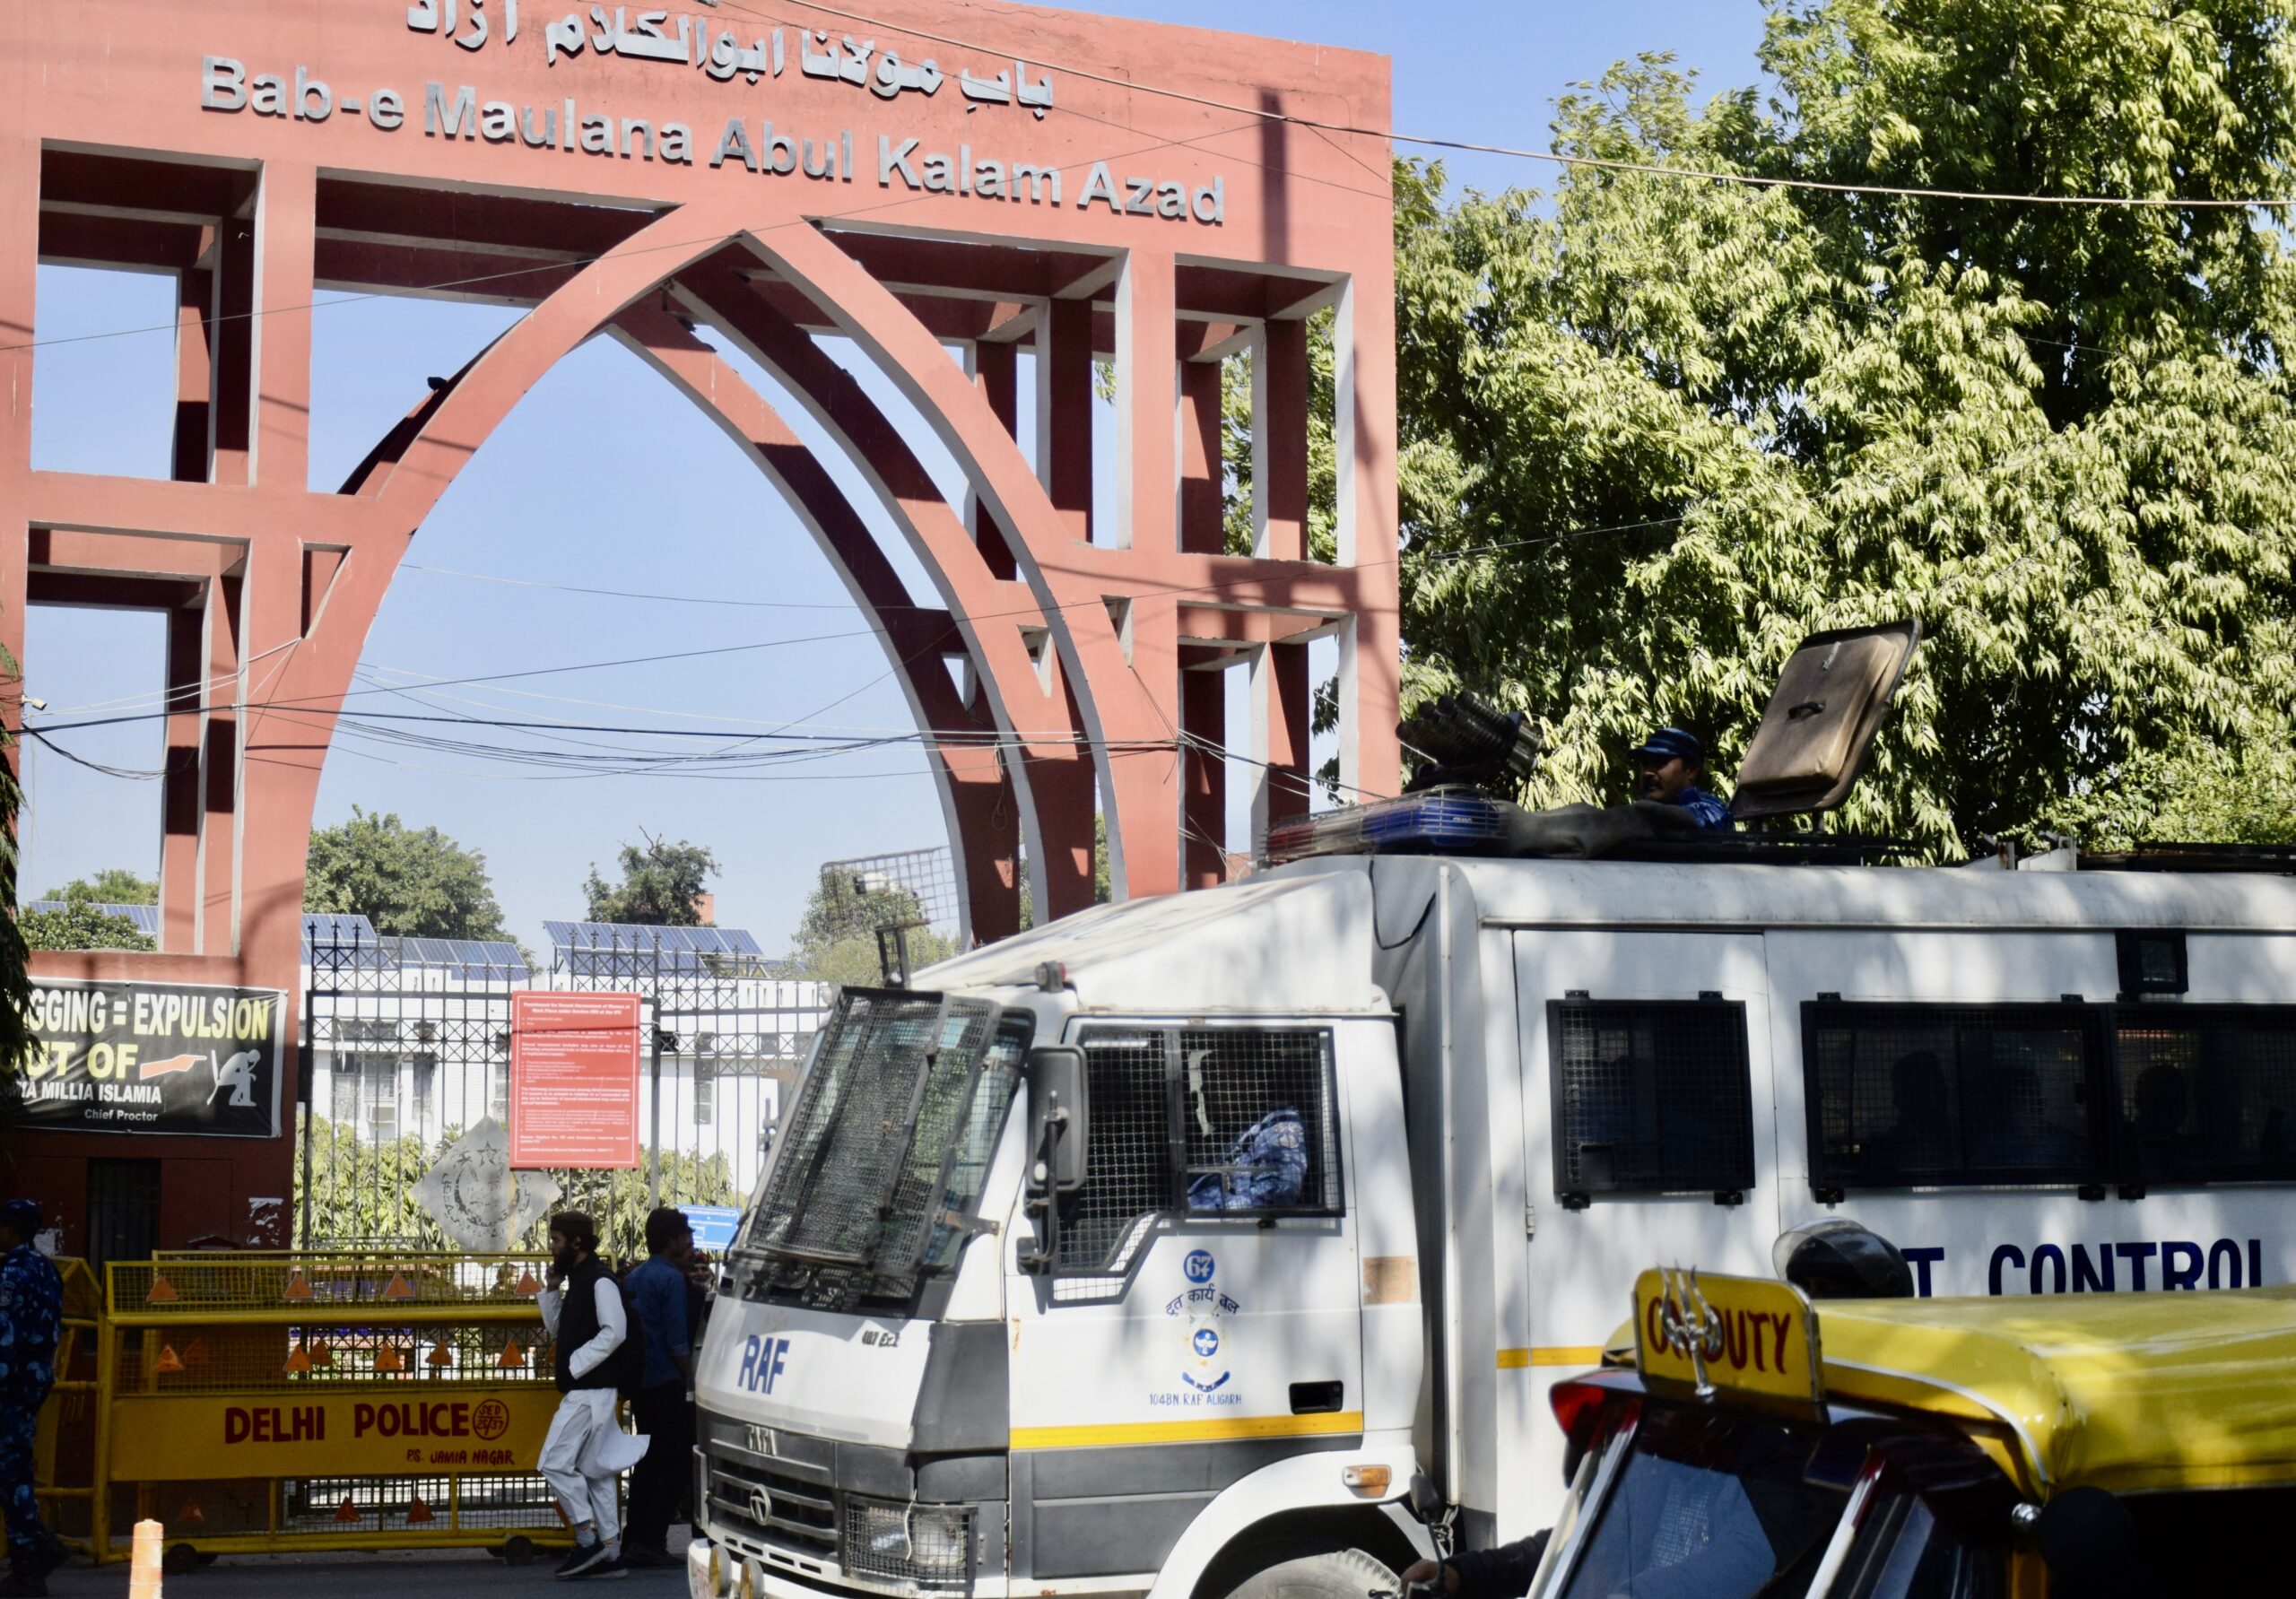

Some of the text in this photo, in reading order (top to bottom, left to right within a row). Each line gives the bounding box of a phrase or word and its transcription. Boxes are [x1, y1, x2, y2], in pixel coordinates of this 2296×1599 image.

[800, 28, 944, 100] مولانا
[200, 55, 1225, 226] Bab-e Maulana Abul Kalam Azad
[134, 993, 271, 1041] EXPULSION
[86, 1042, 139, 1080] OF
[41, 1081, 94, 1101] MILLIA
[99, 1082, 162, 1104] ISLAMIA
[84, 1108, 159, 1122] Chief Proctor
[1900, 1247, 1945, 1298] T
[737, 1334, 790, 1395] RAF
[1183, 1393, 1204, 1406] RAF
[224, 1402, 470, 1445] DELHI POLICE
[745, 1423, 778, 1457] TATA
[430, 1449, 468, 1464] JAMIA
[472, 1449, 515, 1467] NAGAR
